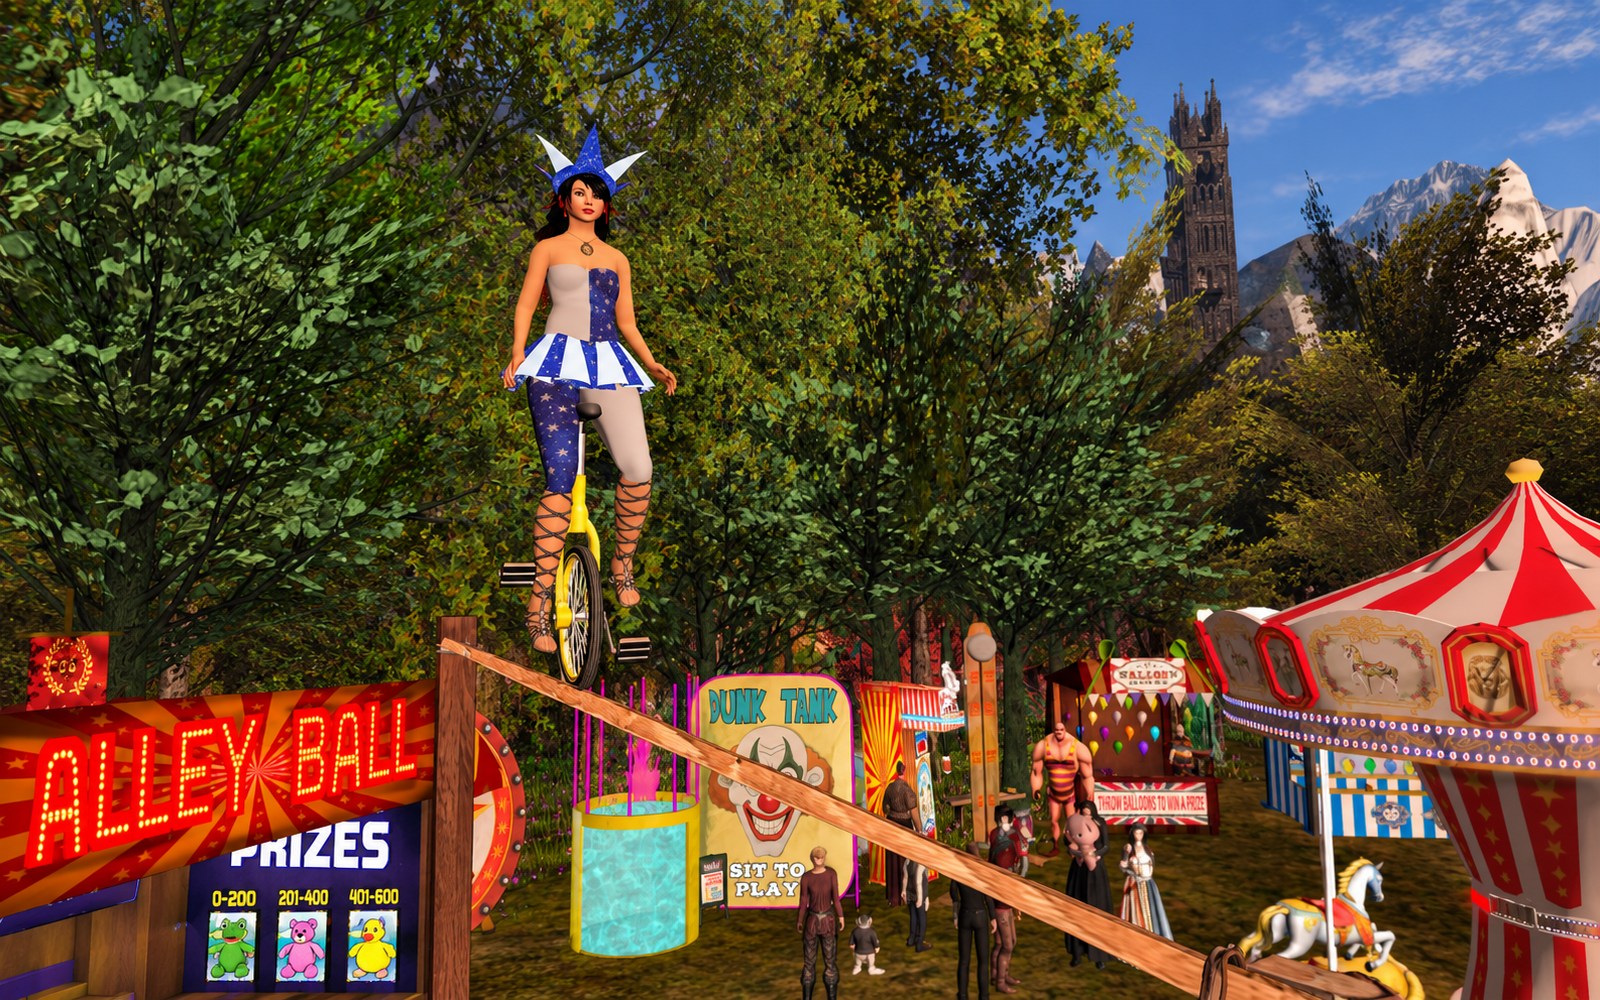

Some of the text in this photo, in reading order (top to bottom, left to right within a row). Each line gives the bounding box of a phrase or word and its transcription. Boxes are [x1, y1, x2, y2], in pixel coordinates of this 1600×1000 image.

[708, 687, 838, 724] DUNK TANK
[25, 698, 418, 869] ALLEY BALL
[1098, 794, 1205, 811] THROW BALLOONS TO WIN A PRIZE
[729, 862, 768, 878] SIT
[773, 862, 806, 878] TO
[278, 889, 329, 906] 201-400
[349, 888, 399, 905] 401-600
[735, 881, 800, 897] PLAY
[212, 890, 257, 907] 0-200
